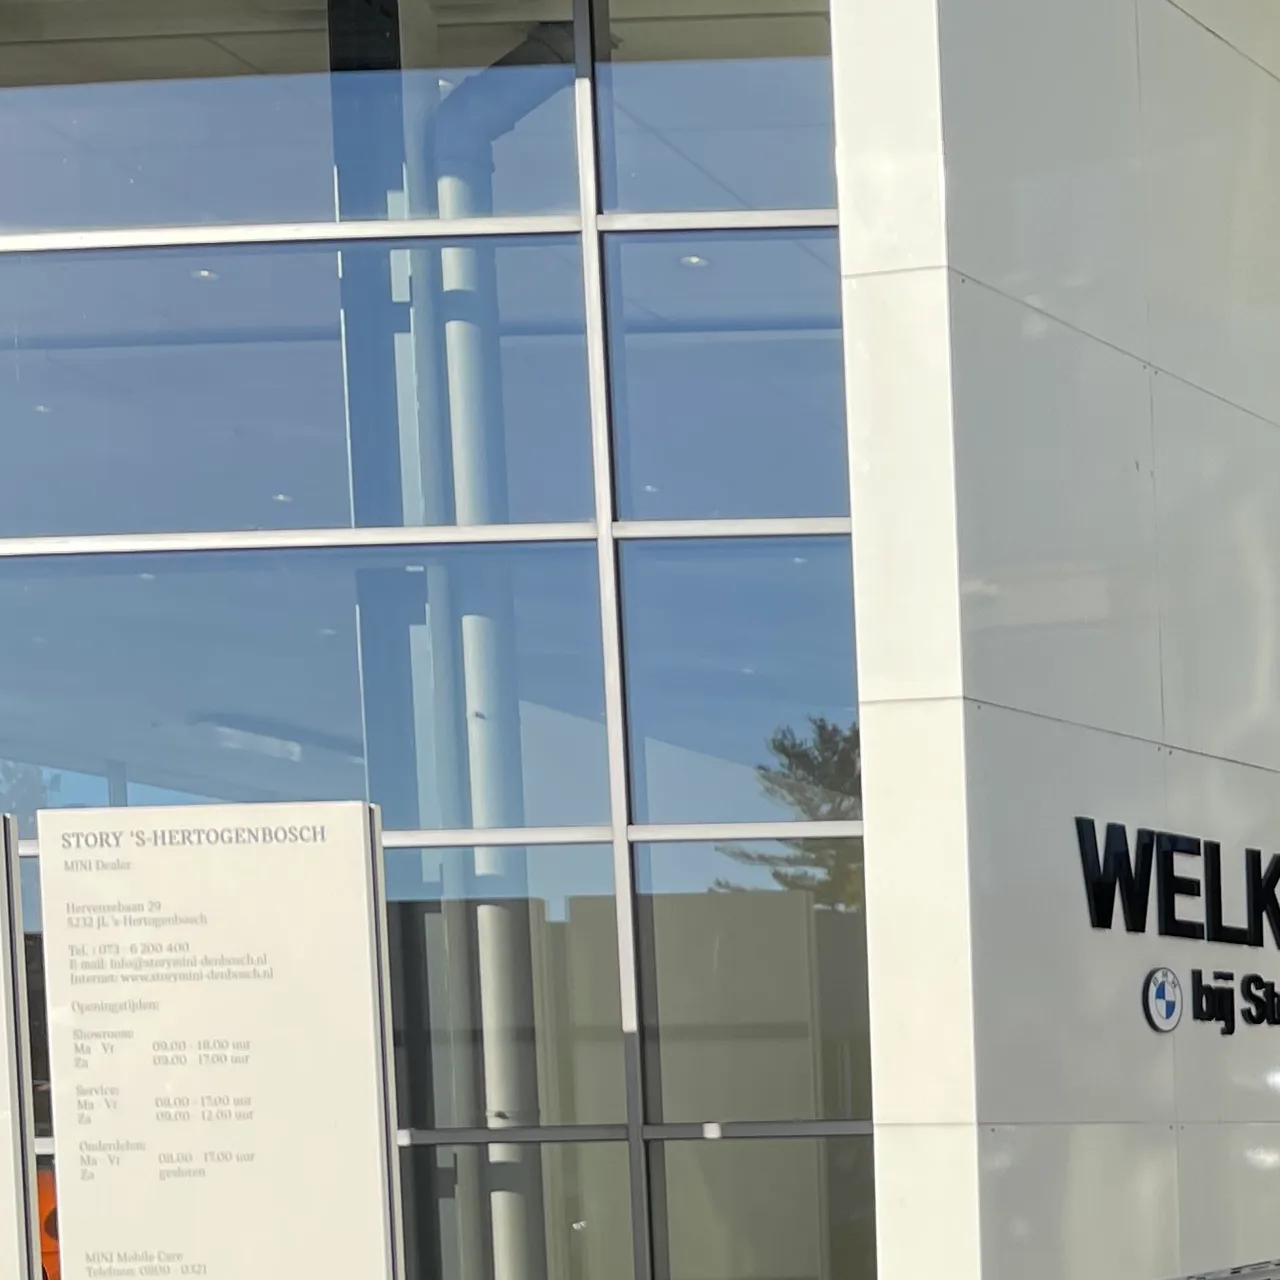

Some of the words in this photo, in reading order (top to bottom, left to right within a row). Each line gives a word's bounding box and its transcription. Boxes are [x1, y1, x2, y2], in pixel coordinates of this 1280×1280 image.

[61, 830, 123, 849] STORY
[64, 860, 92, 871] MINI
[96, 859, 131, 871] Dealer
[1191, 969, 1235, 1035] bij
[85, 1252, 113, 1264] MINI
